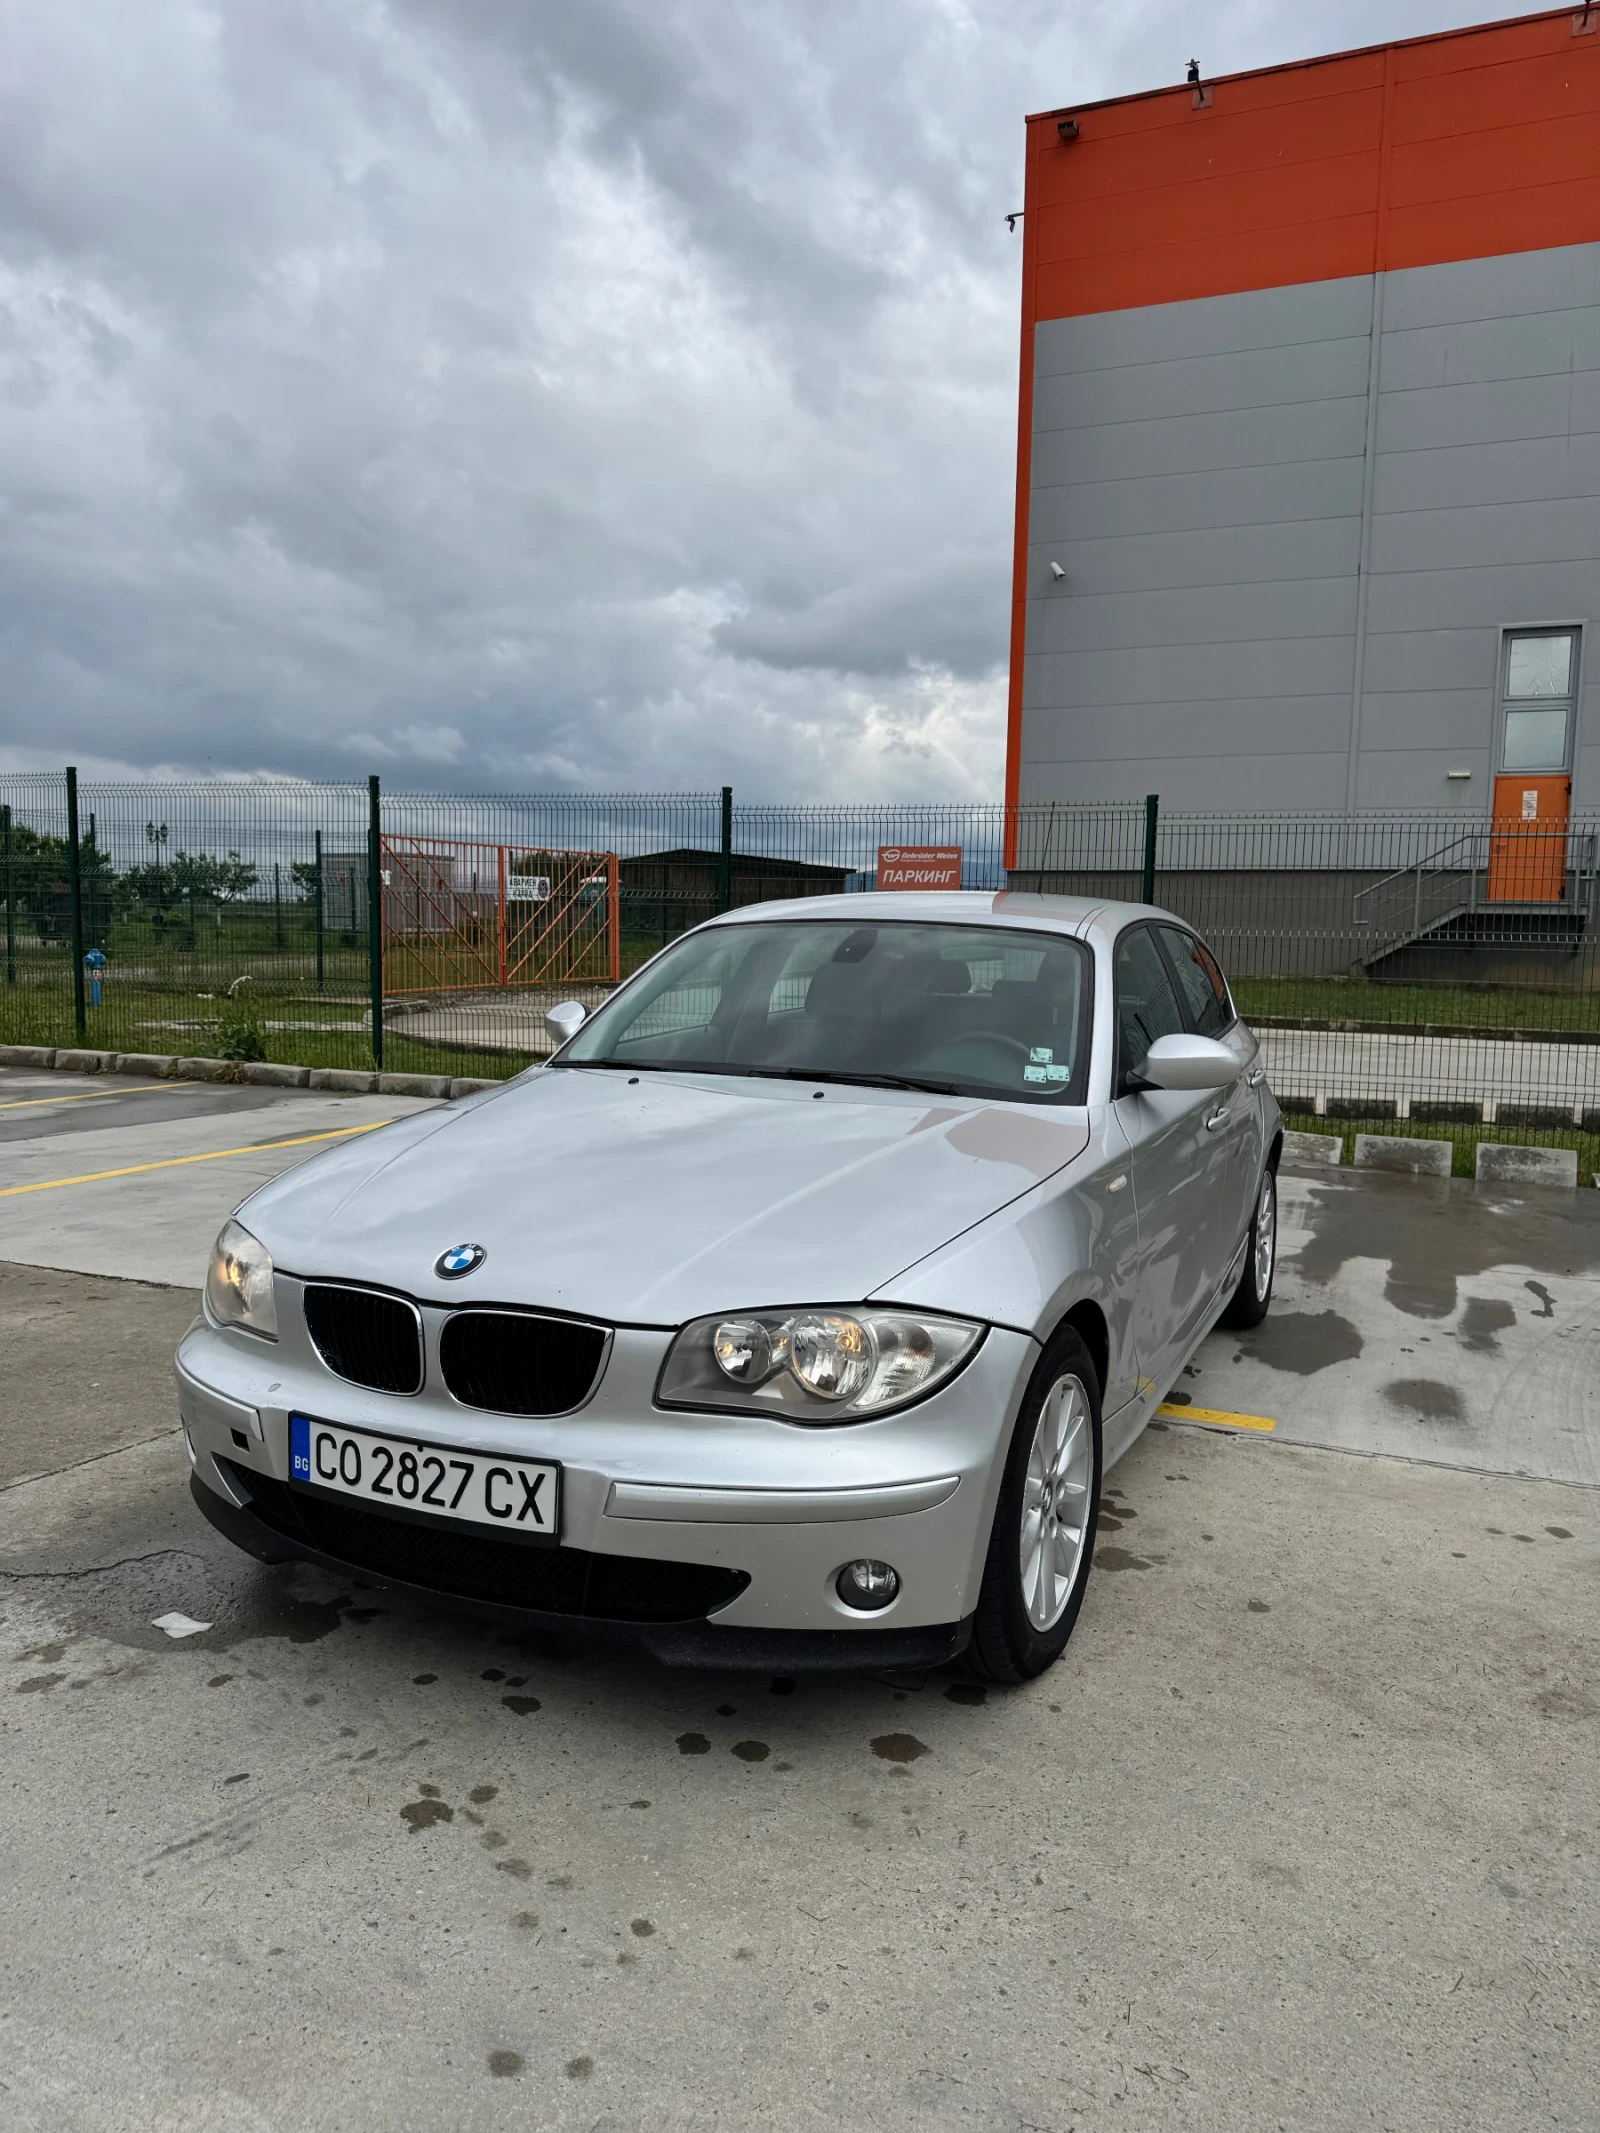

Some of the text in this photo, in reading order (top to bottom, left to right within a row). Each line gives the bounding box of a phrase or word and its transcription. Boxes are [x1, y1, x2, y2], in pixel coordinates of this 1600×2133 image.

[509, 878, 537, 887] АВАРИЕН
[882, 869, 956, 883] ПАРКИНГ
[294, 1455, 309, 1471] BG
[371, 1446, 474, 1509] 2827
